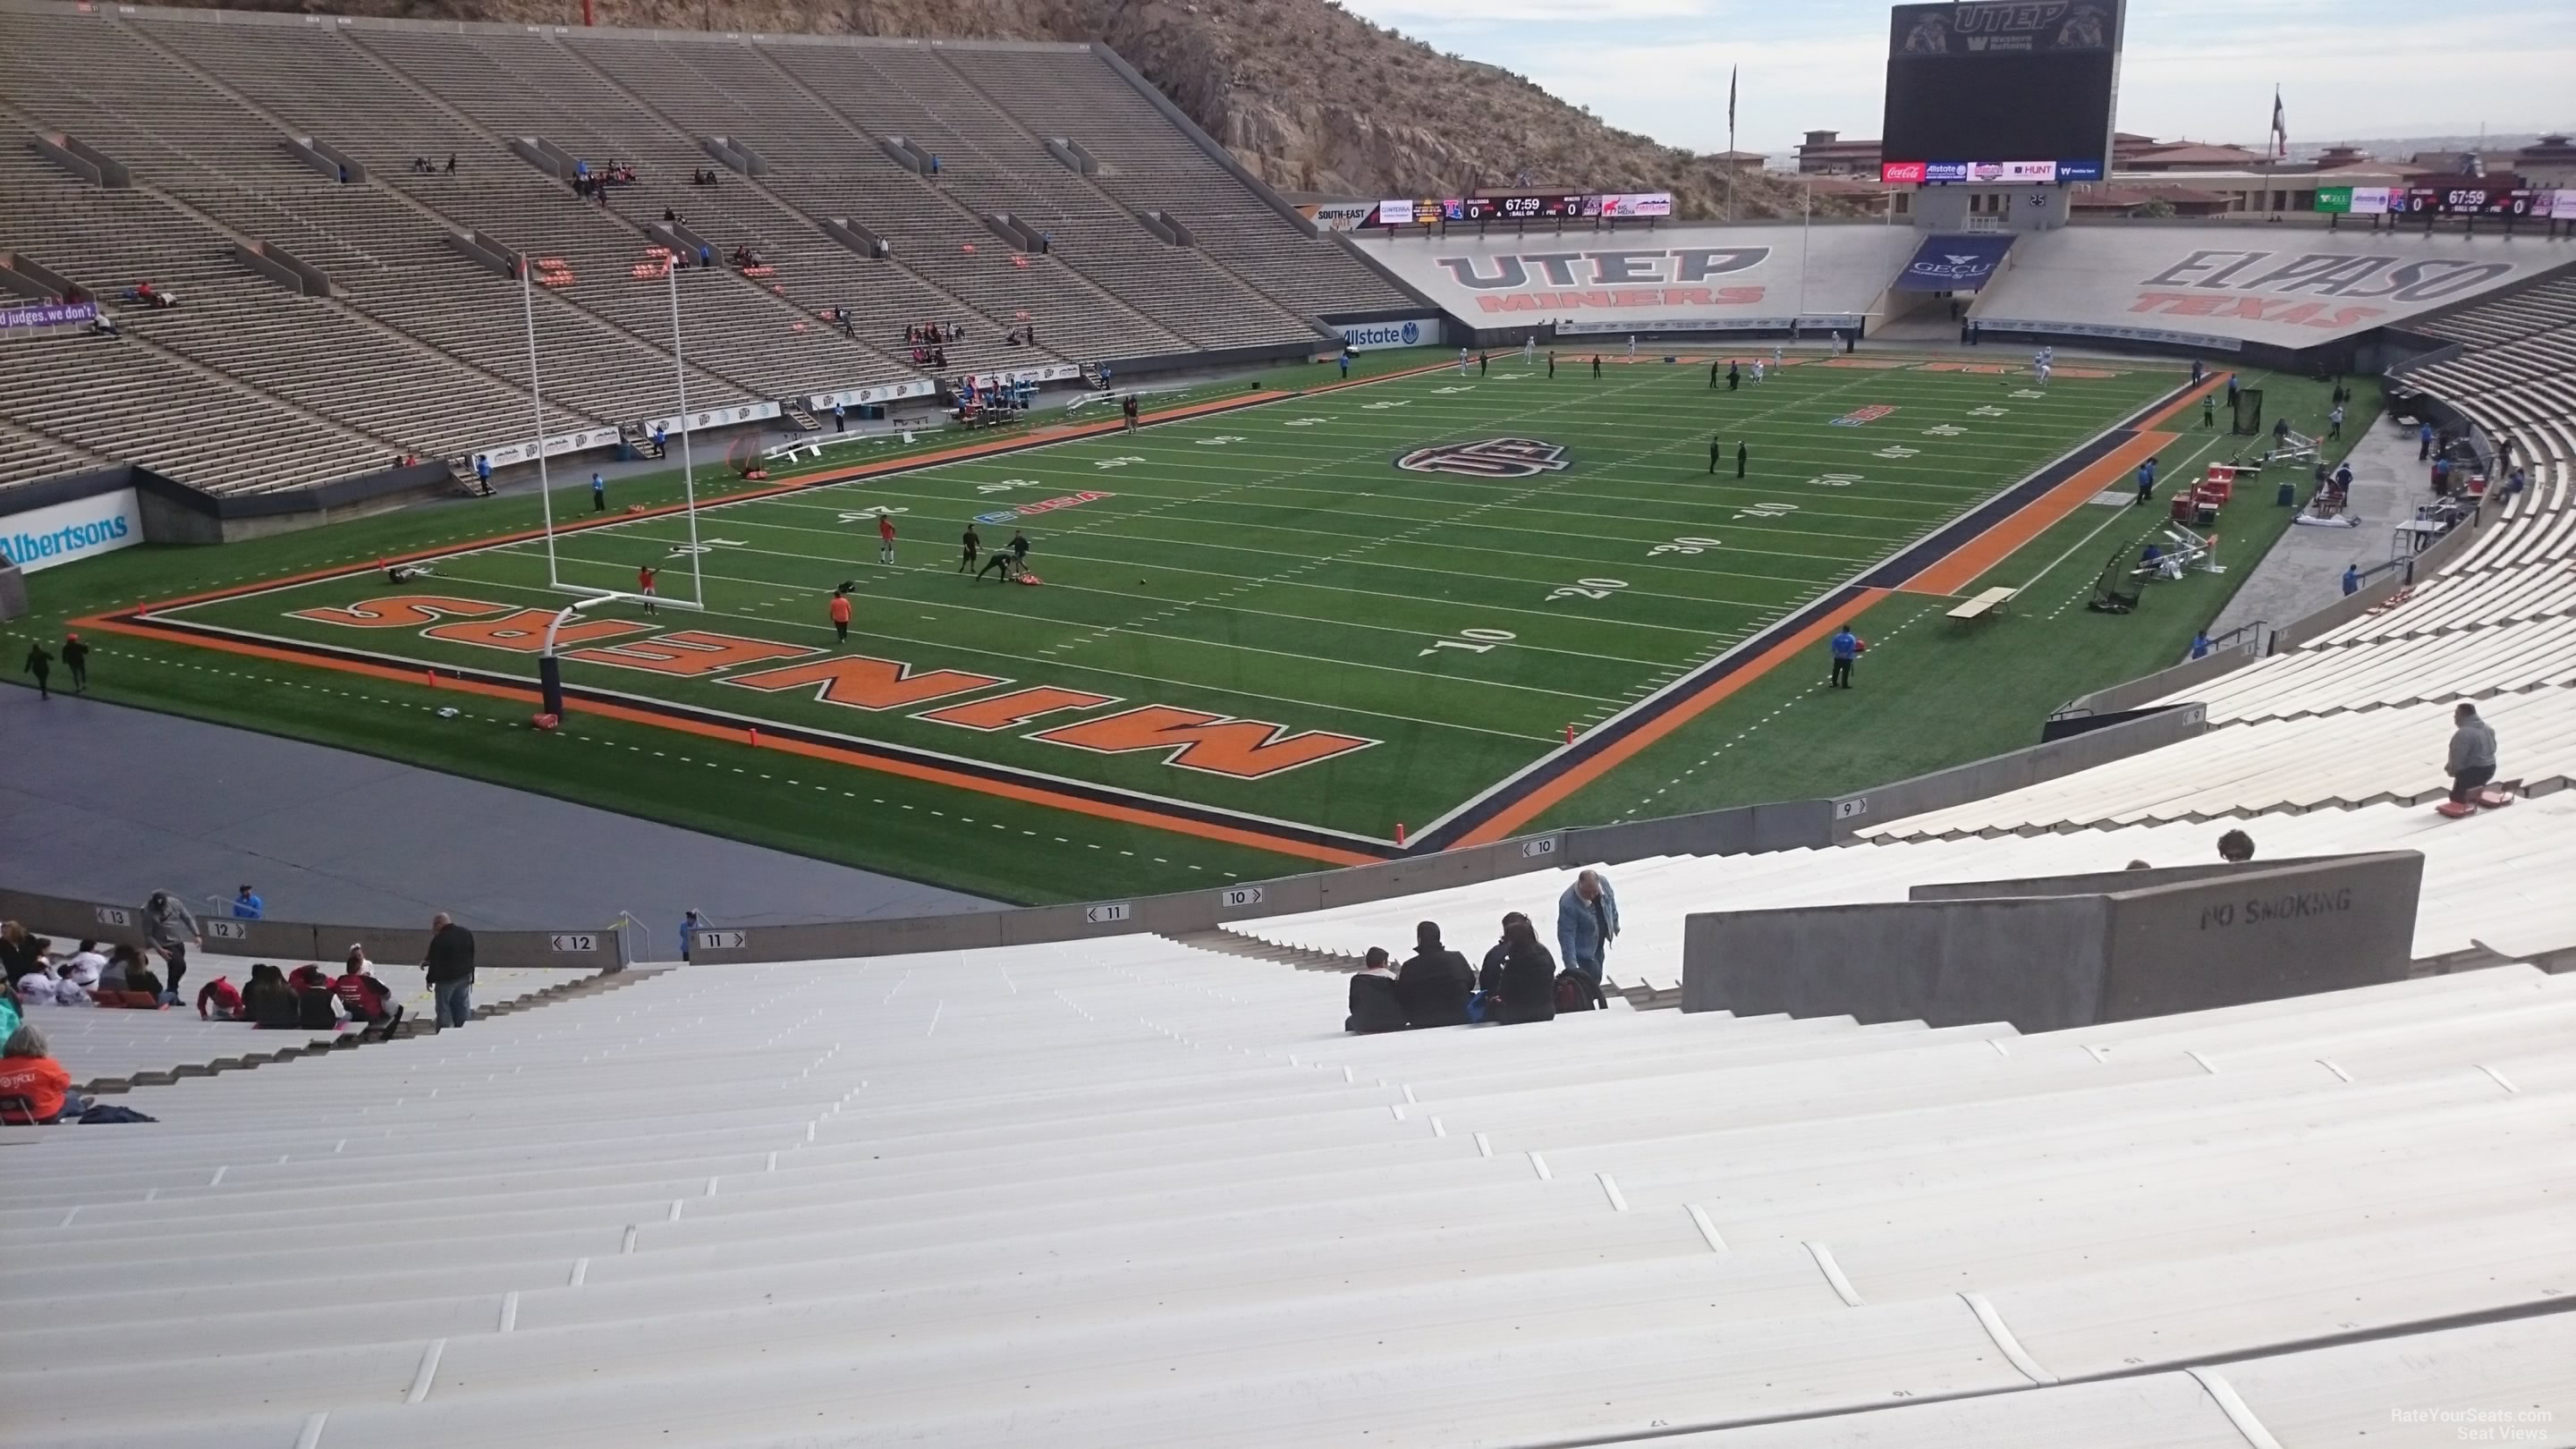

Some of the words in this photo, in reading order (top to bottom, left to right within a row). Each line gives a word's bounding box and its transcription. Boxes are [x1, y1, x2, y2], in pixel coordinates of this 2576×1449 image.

[1954, 1, 2068, 33] UTEP
[2030, 195, 2045, 205] 25
[2449, 190, 2486, 204] 67:59
[1506, 199, 1540, 210] 67:59
[1568, 204, 1576, 215] 0
[2413, 198, 2422, 211] 0
[2514, 199, 2523, 214] 0
[1318, 209, 1365, 220] SOUTH-EAST
[1470, 207, 1479, 218] 0
[1333, 218, 1352, 227] GATE
[1437, 247, 1773, 291] UTEP
[1914, 262, 1996, 274] GECU
[1477, 287, 1766, 312] MINERS
[2128, 292, 2390, 328] TEXAS
[1344, 327, 1399, 345] Allstate
[1807, 473, 1865, 486] 50
[1739, 503, 1800, 517] 40
[0, 515, 128, 564] Albertsons
[1653, 537, 1722, 555] 30
[1554, 578, 1630, 600] 20
[1433, 628, 1517, 653] 10
[282, 595, 1385, 780] MINERS
[1844, 803, 1851, 815] 9
[1538, 841, 1551, 853] 10
[1230, 892, 1245, 904] 10
[1107, 907, 1120, 919] 11
[2200, 902, 2234, 930] NO
[2245, 888, 2351, 924] SMOKING
[111, 911, 123, 924] 13
[215, 924, 229, 936] 12
[571, 936, 590, 949] 12
[708, 934, 721, 947] 11
